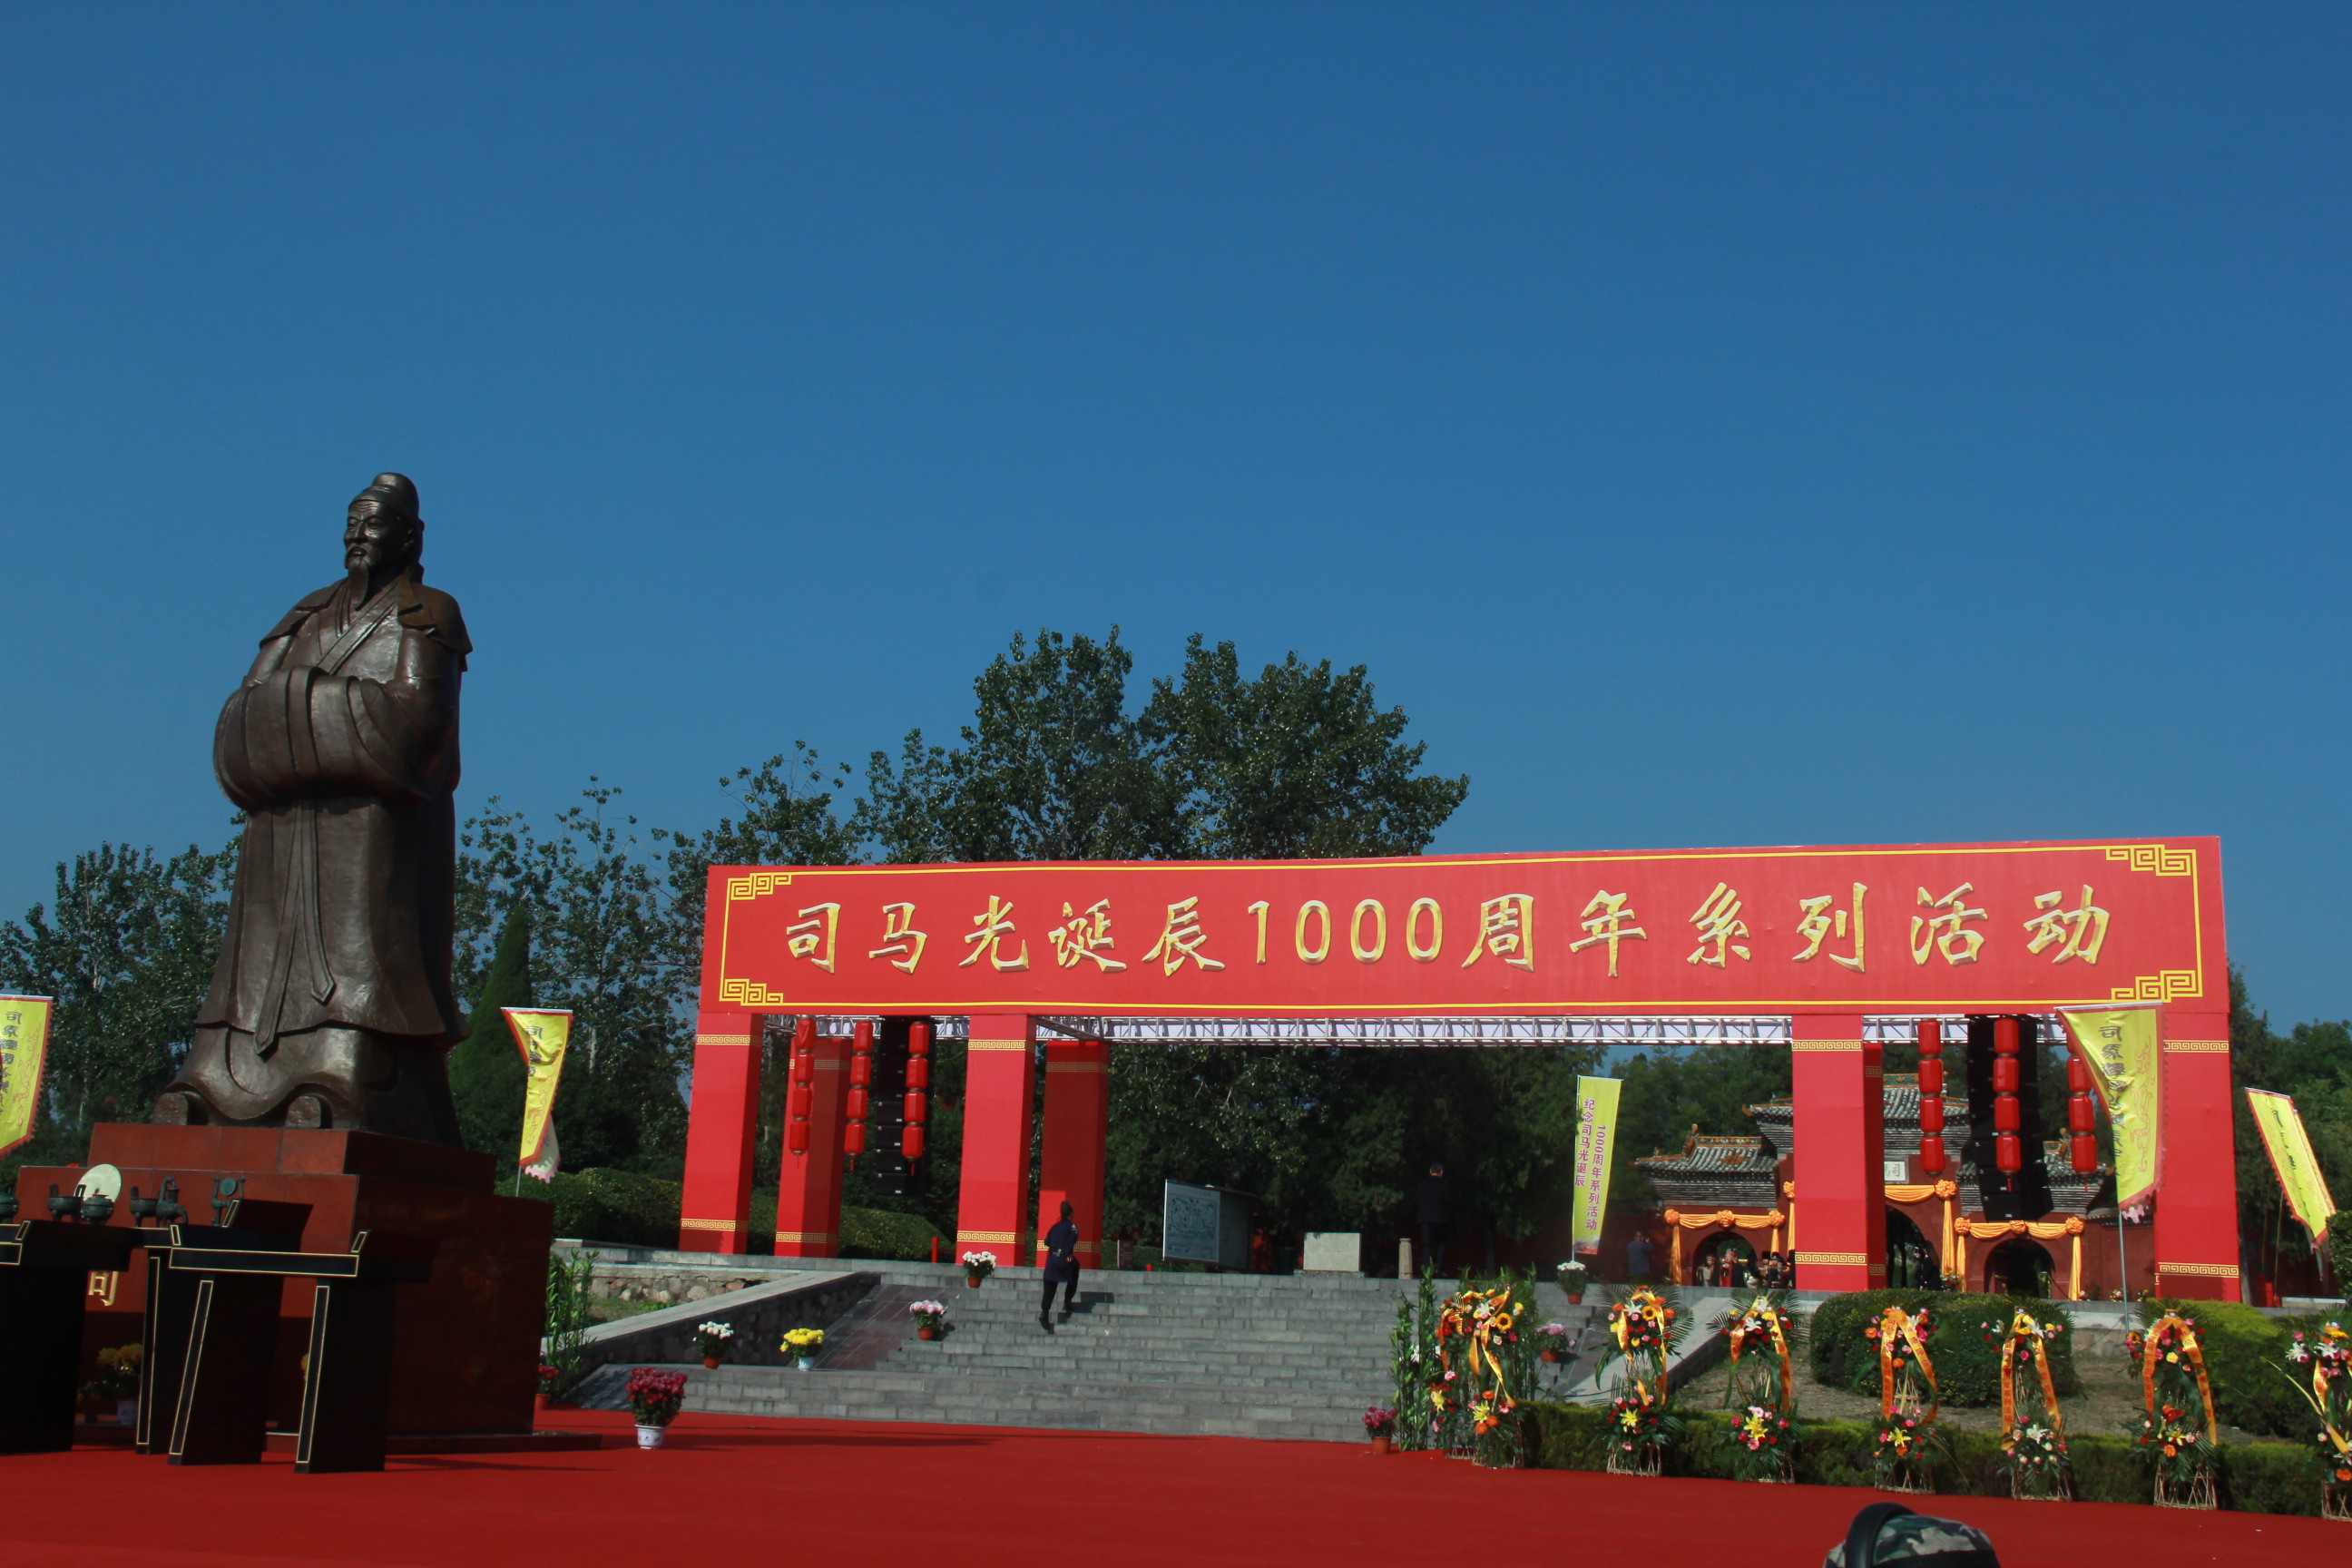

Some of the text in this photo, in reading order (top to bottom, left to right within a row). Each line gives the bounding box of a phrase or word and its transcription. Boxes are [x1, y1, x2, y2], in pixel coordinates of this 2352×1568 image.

[785, 880, 2112, 978] 司马光诞辰1000周年系列活动
[1574, 1098, 1596, 1187] 纪念司马光诞辰
[1585, 1124, 1607, 1230] 1000周年系列活动
